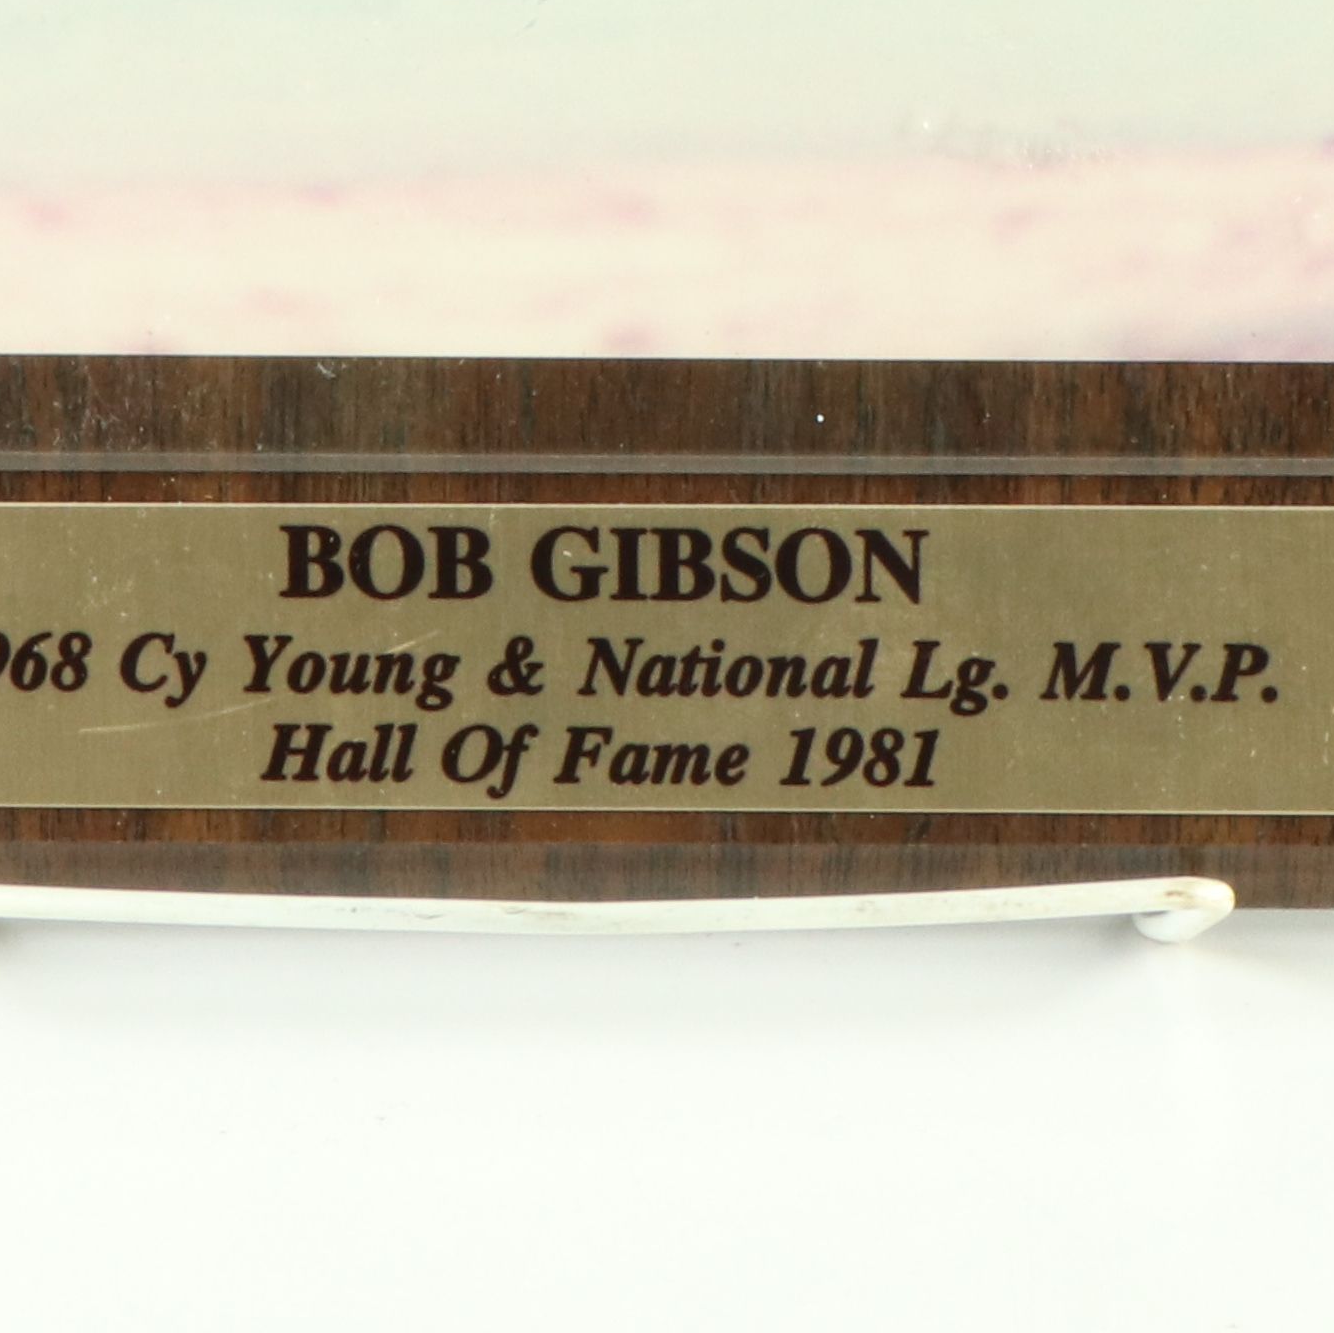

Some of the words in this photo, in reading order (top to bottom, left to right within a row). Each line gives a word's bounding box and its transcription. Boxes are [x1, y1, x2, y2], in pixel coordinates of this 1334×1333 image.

[278, 524, 494, 601] BOB
[530, 525, 930, 605] GIBSON
[119, 632, 208, 709] Cy
[243, 634, 461, 712] Young
[486, 635, 544, 697] &
[576, 637, 879, 699] National
[899, 640, 1009, 717] Lg.
[1039, 641, 1278, 704] M.V.P.
[260, 722, 418, 783] Hall
[441, 723, 540, 800] Of
[552, 726, 750, 787] Fame
[779, 727, 940, 788] 1981
